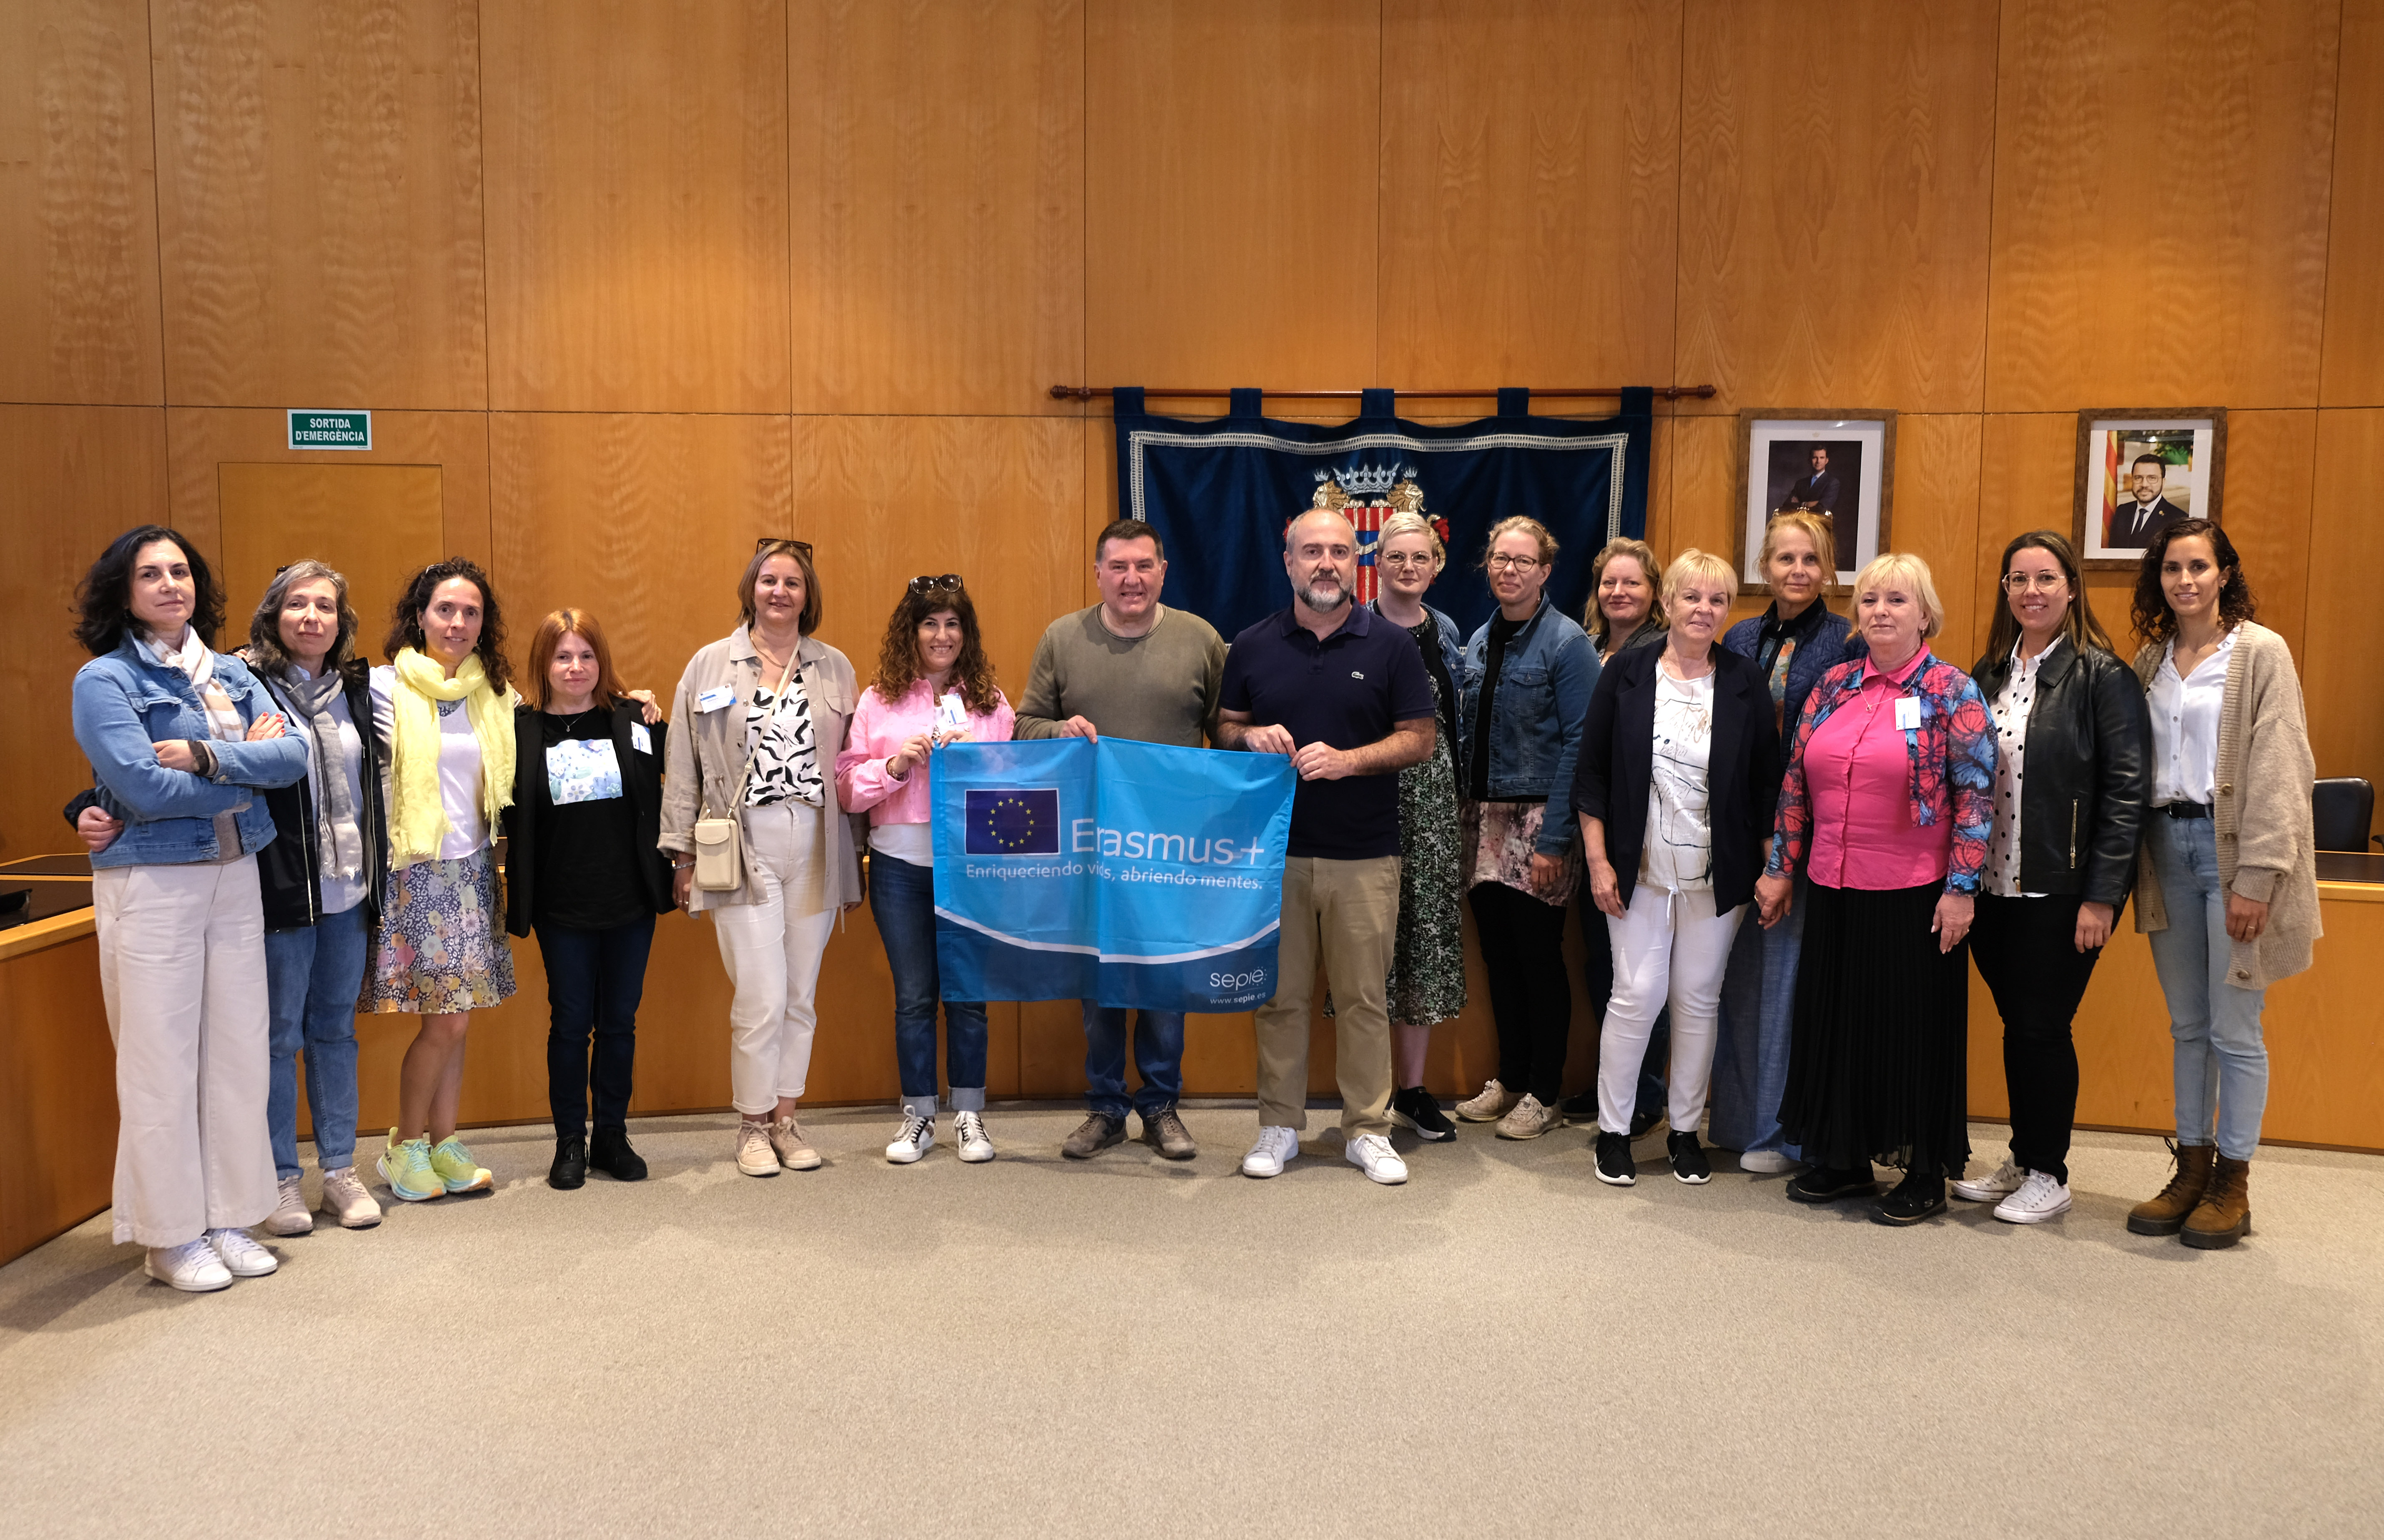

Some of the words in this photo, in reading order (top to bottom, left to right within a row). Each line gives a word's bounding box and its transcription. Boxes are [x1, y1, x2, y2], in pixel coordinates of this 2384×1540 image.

[310, 418, 351, 429] SORTIDA
[296, 429, 365, 441] D'EMERGÈNCIA
[1072, 818, 1264, 865] Erasmus+
[966, 860, 1083, 881] Enriqueciendo
[1087, 860, 1115, 882] vids,
[1121, 865, 1196, 885] abriendo
[1200, 875, 1262, 889] mentes.
[1210, 969, 1264, 991] sepie
[1210, 992, 1266, 1004] www.sepie.es
